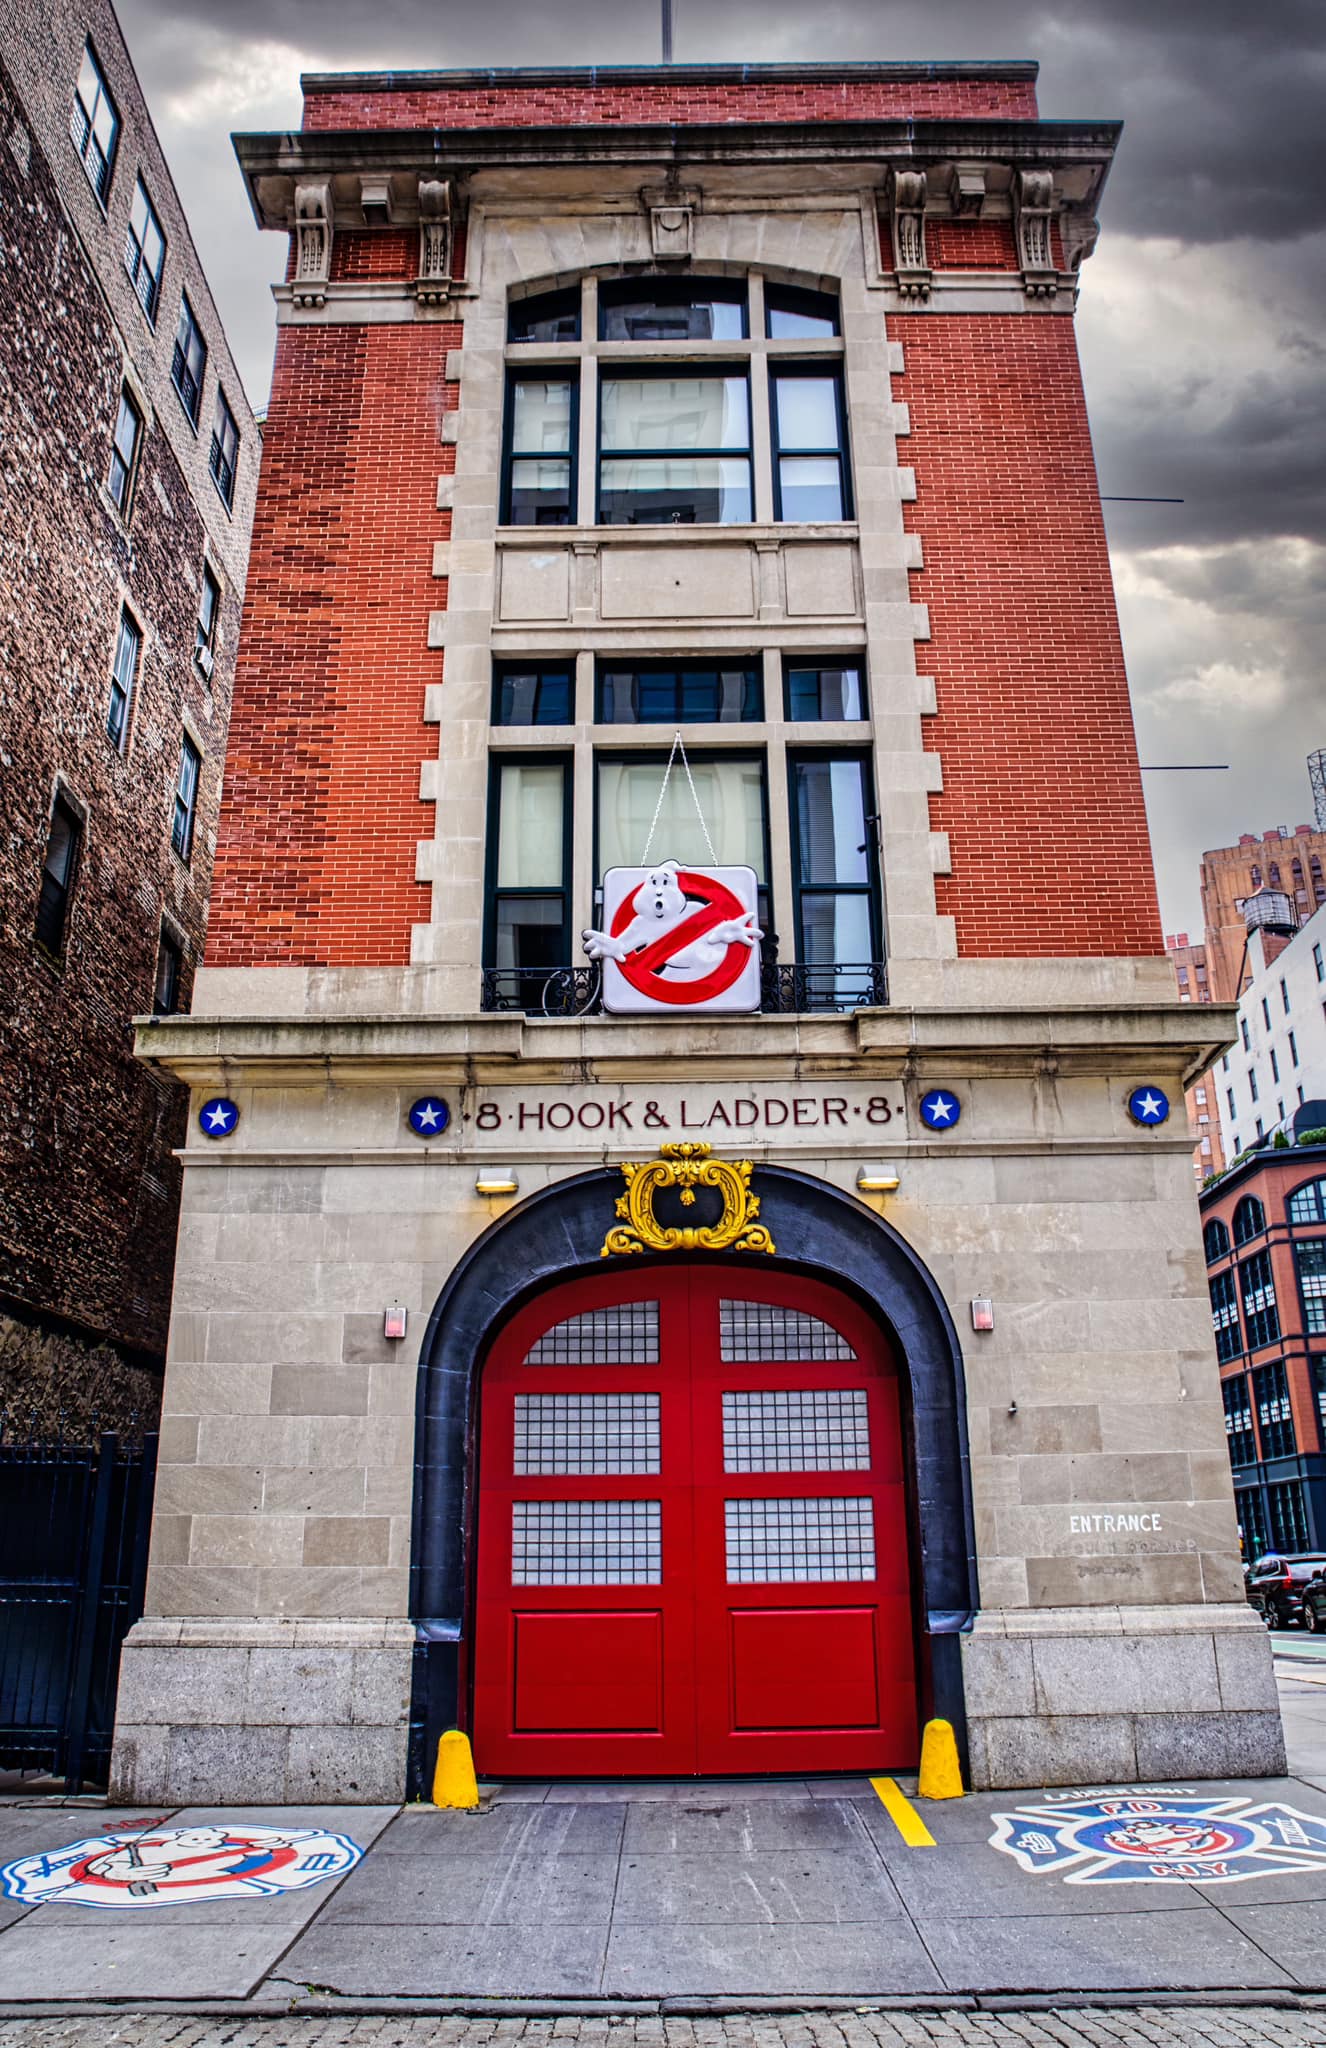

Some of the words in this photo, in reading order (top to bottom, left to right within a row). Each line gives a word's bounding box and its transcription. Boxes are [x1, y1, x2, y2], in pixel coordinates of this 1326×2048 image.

[518, 1101, 633, 1130] HOOK
[643, 1101, 671, 1128] &
[680, 1098, 849, 1127] LADDER
[1070, 1513, 1163, 1533] ENTRANCE
[1044, 1788, 1132, 1801] LADDER
[1131, 1787, 1198, 1795] EIGHT
